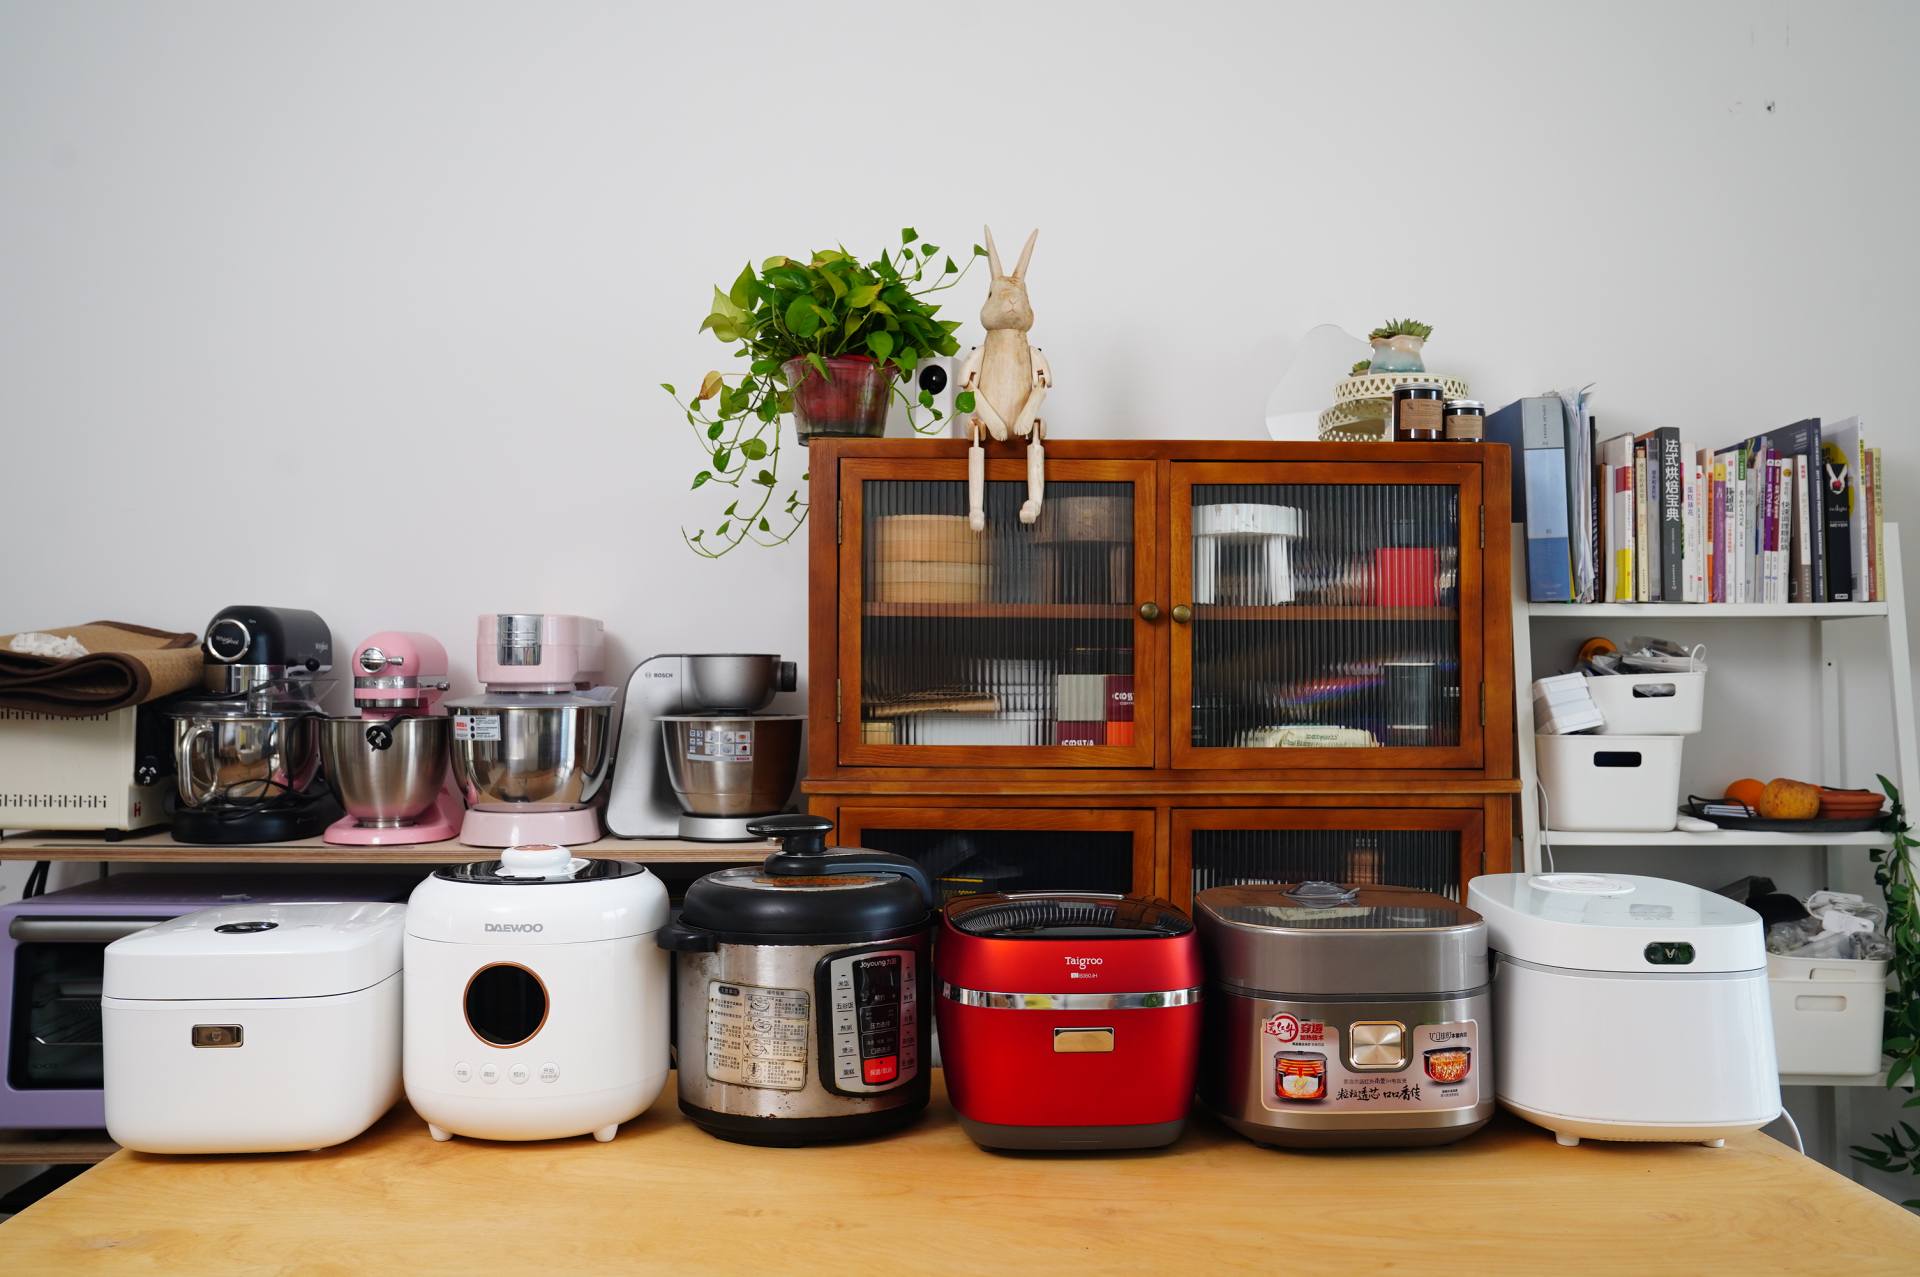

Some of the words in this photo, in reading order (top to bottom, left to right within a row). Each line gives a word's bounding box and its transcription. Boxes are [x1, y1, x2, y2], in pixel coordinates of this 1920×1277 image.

[1664, 439, 1680, 522] 法式烘焙宝典
[484, 923, 544, 933] DAEWOO
[860, 960, 887, 968] Joyoung
[1064, 956, 1103, 970] Taigroo
